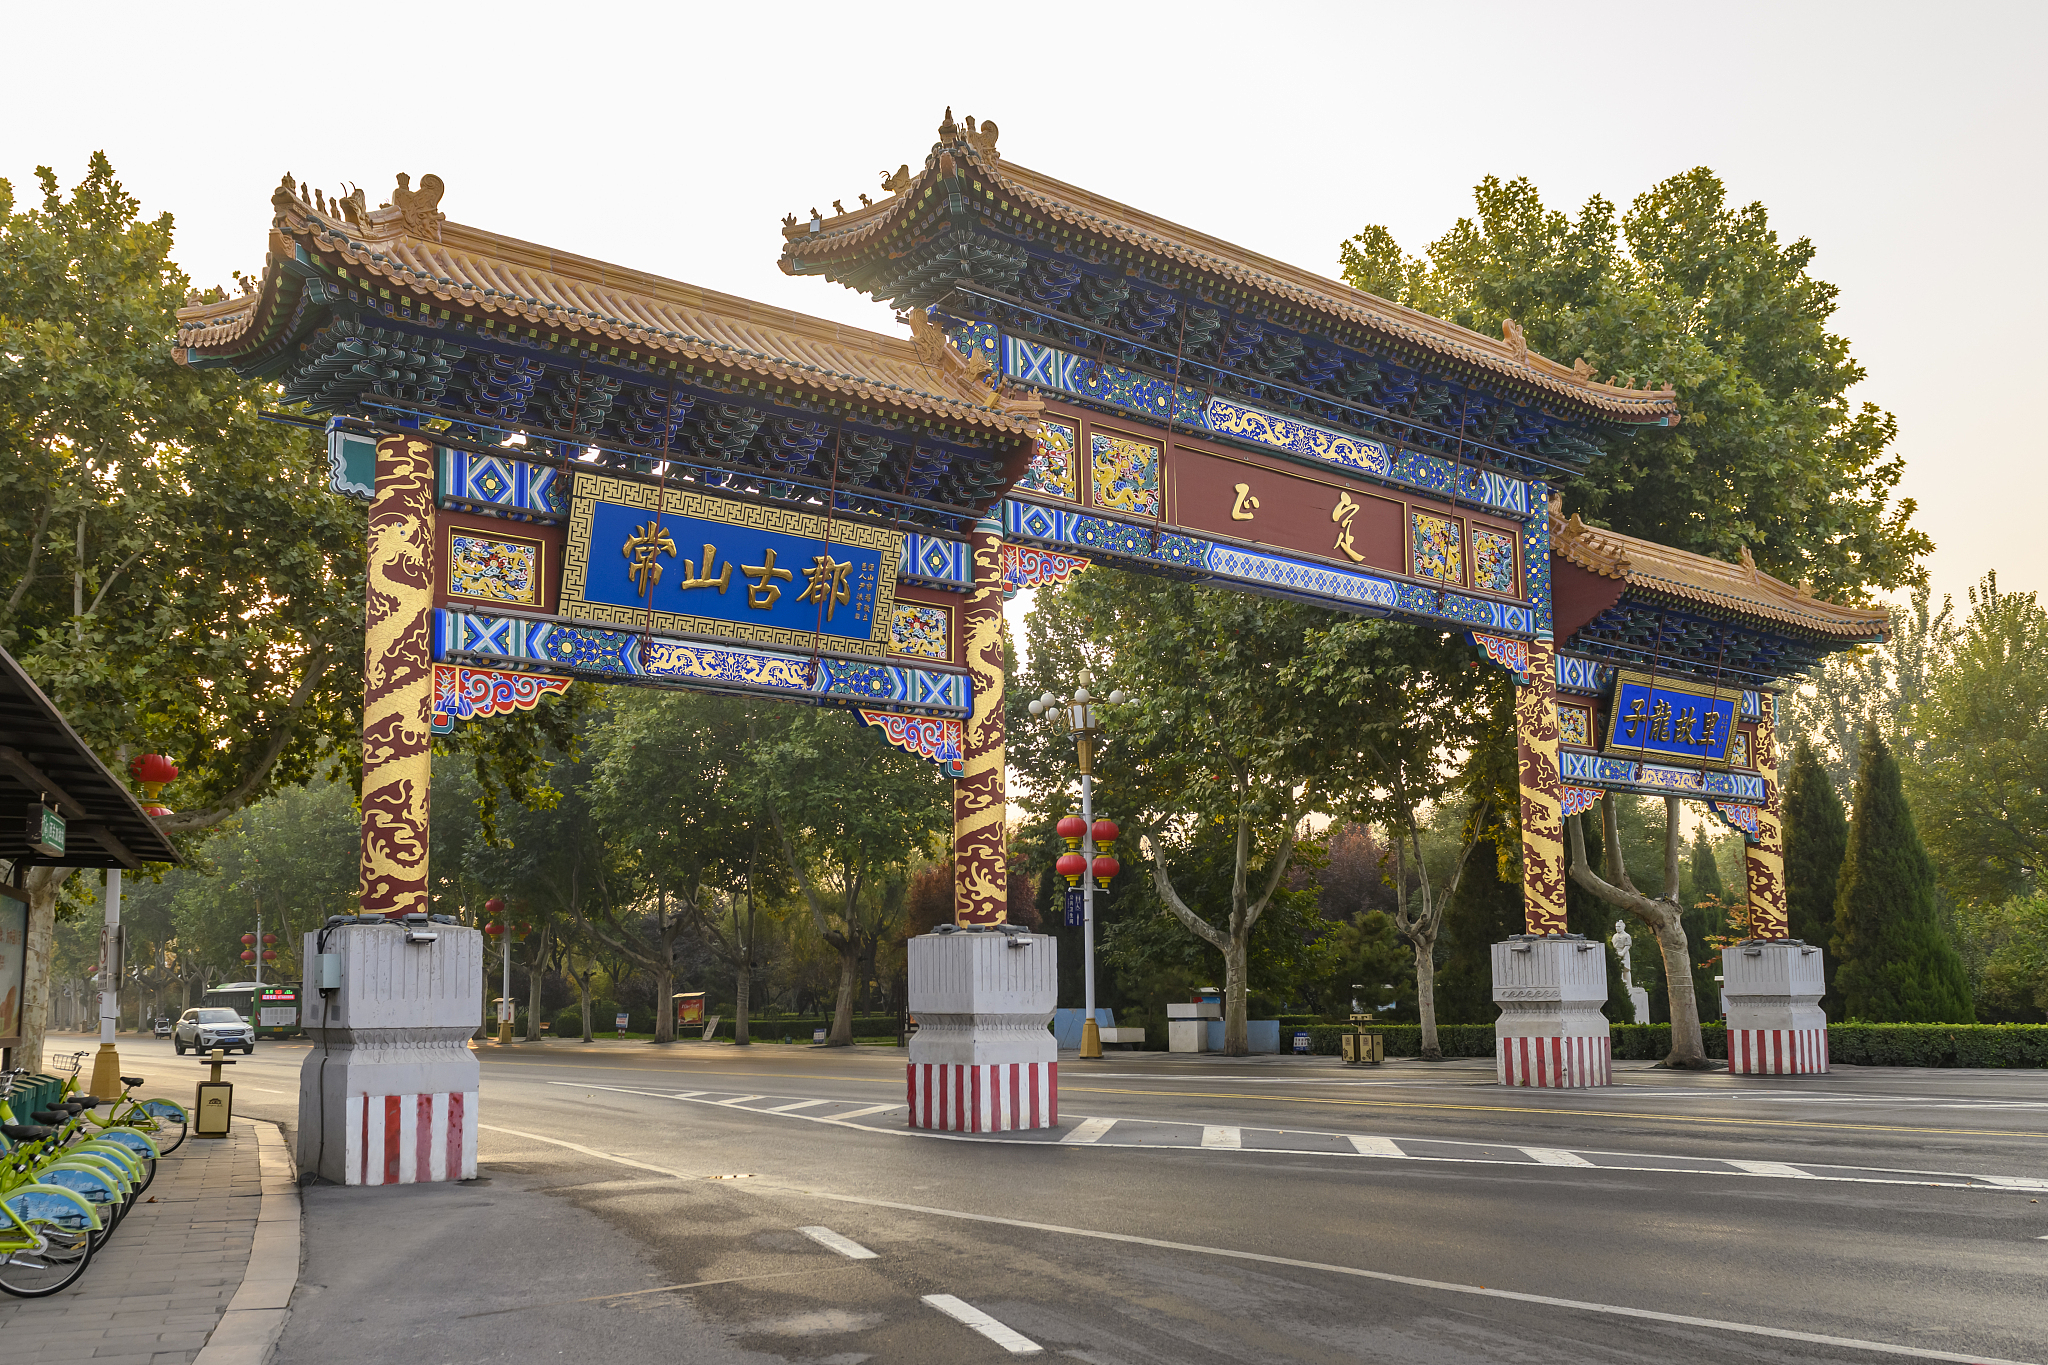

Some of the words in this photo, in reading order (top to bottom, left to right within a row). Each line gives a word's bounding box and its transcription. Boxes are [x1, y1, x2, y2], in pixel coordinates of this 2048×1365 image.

[1232, 482, 1366, 563] 正定
[622, 520, 854, 622] 常山古都
[1623, 698, 1720, 746] 子龍故里
